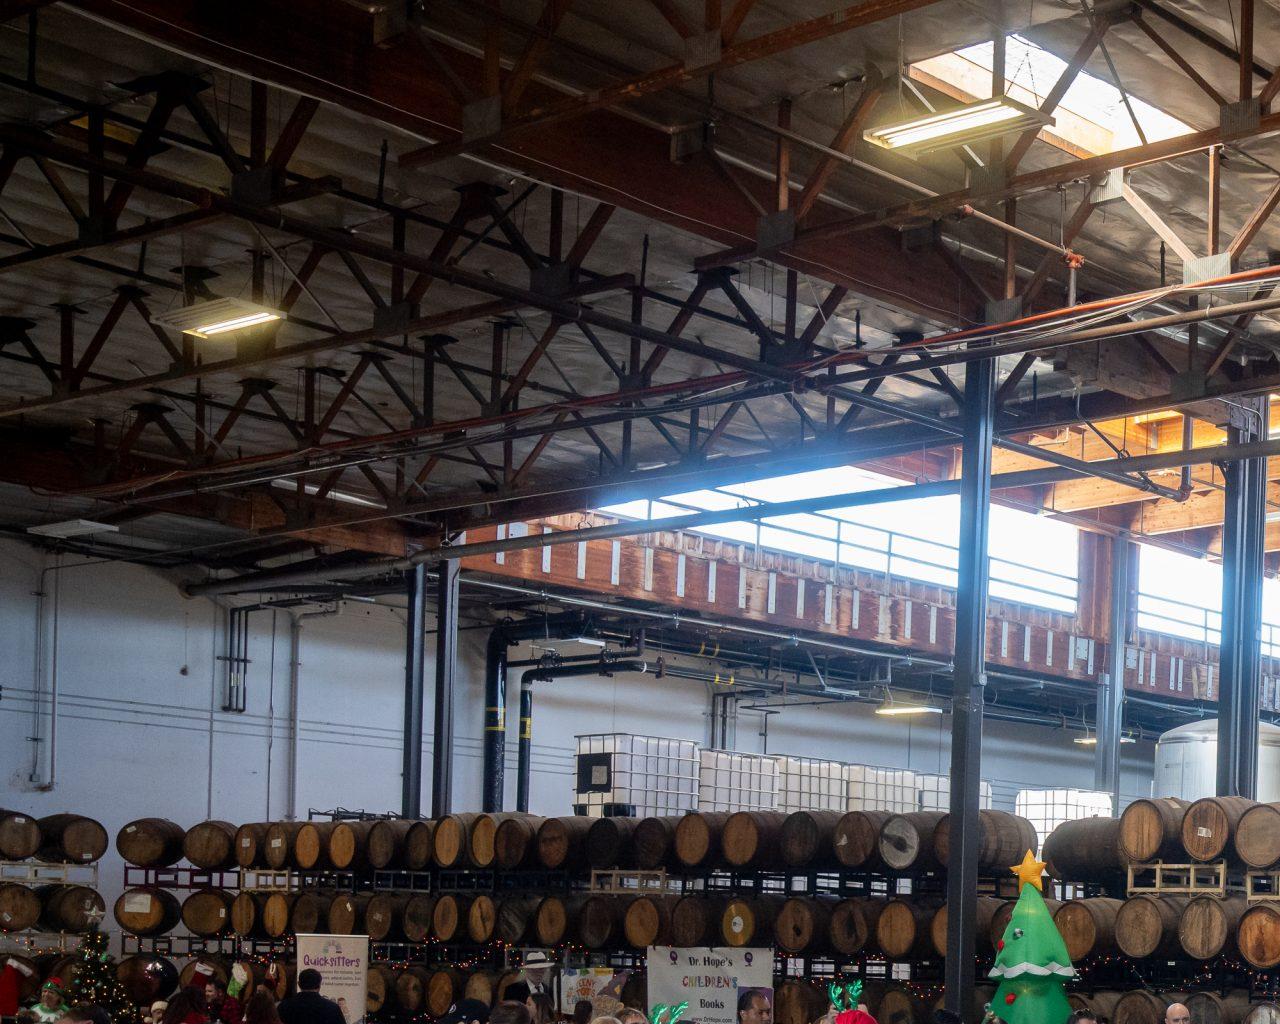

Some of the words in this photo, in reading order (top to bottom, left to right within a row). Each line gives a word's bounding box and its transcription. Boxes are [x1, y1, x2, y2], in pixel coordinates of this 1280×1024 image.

[303, 954, 361, 967] Quicksitters
[688, 956, 701, 967] Dr.
[703, 956, 733, 968] Hope's
[682, 975, 738, 989] CHILDREN'S
[700, 998, 725, 1010] Books
